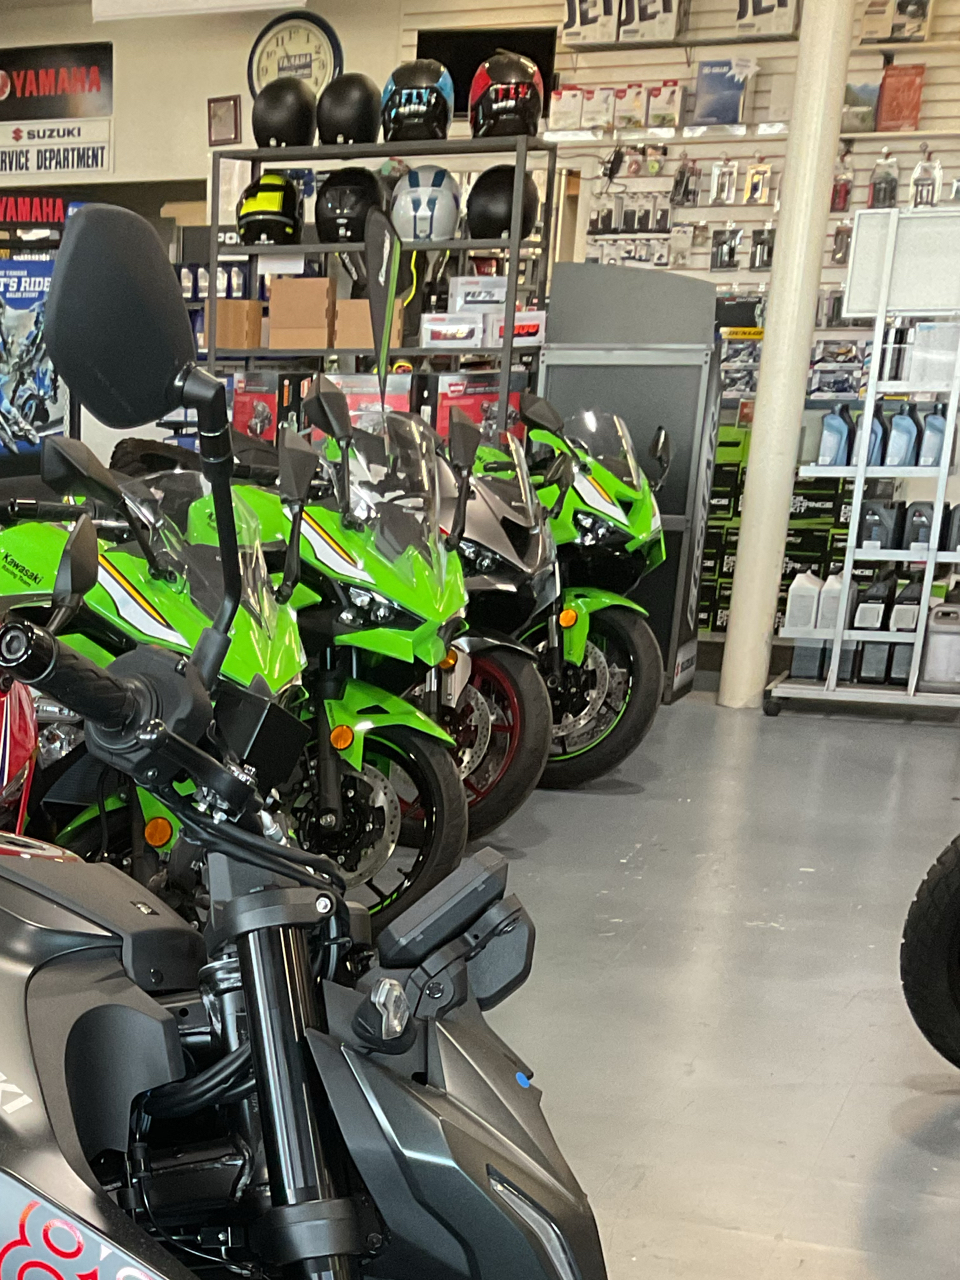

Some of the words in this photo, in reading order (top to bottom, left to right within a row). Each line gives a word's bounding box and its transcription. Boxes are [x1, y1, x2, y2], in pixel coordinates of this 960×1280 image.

[276, 36, 285, 47] 11
[12, 65, 102, 98] YAMAHA
[26, 126, 82, 140] SUZUKI
[36, 146, 106, 171] DEPARTMENT
[20, 277, 52, 292] RIDE
[2, 552, 44, 585] Kawasaki
